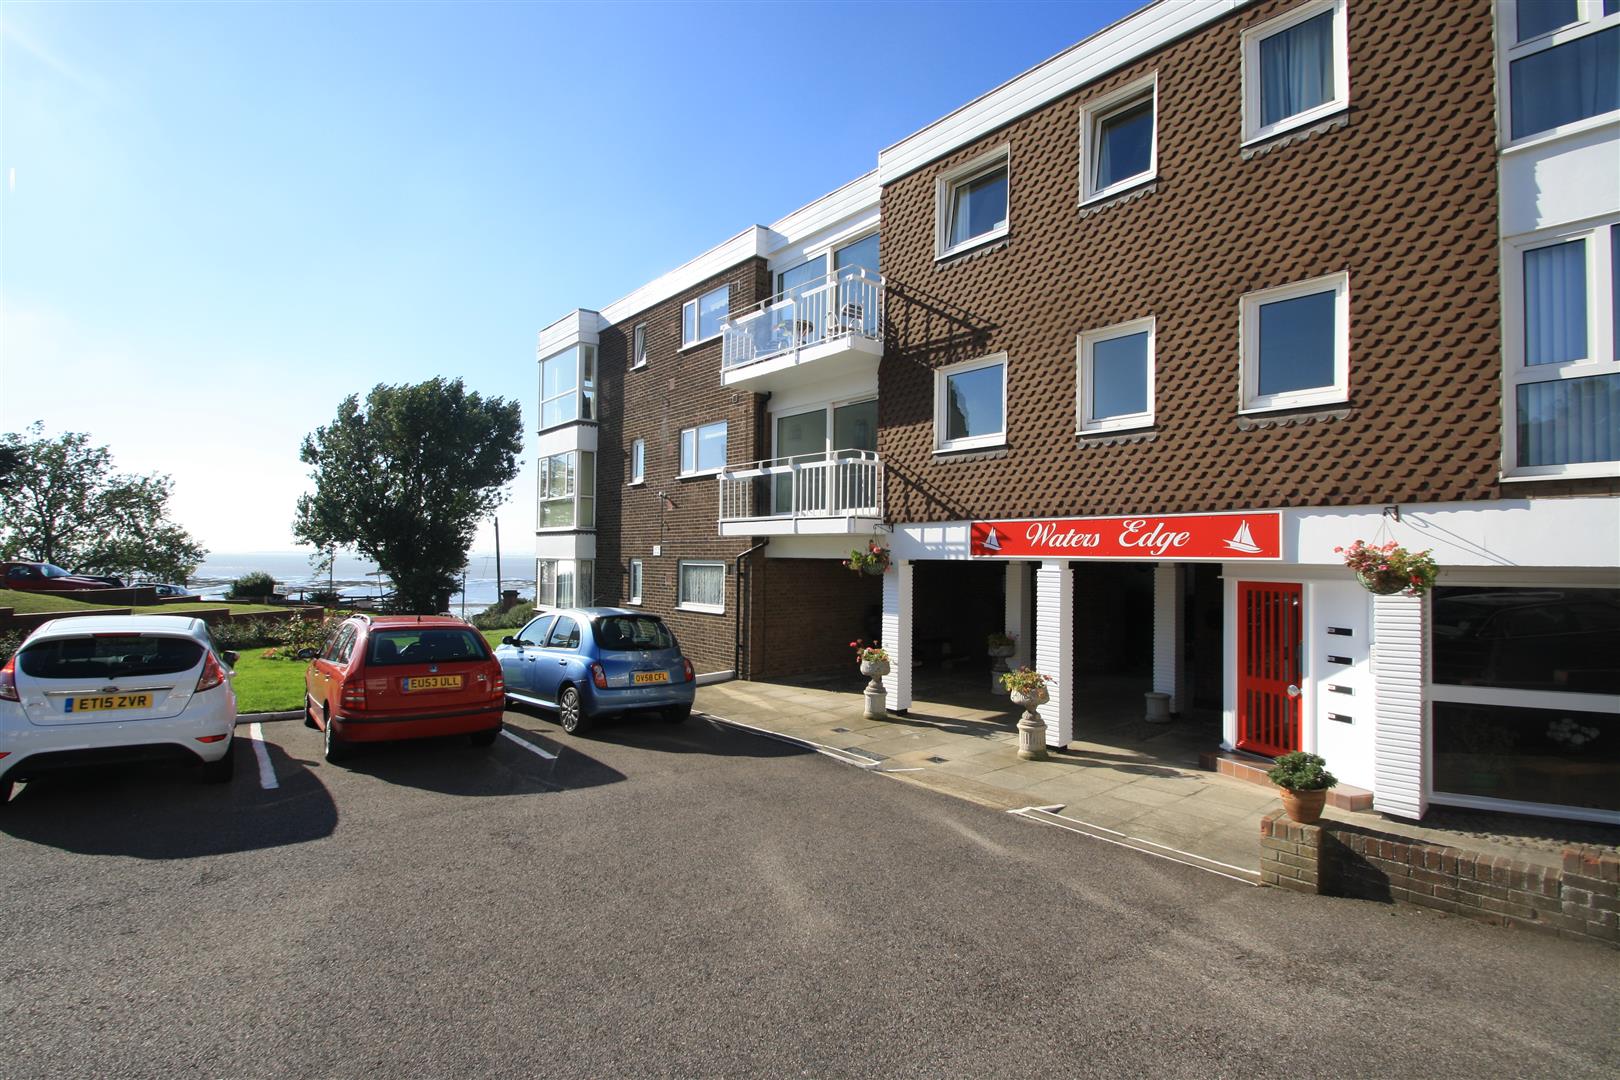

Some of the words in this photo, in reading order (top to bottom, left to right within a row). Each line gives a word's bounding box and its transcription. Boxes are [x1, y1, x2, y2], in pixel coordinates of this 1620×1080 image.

[1026, 522, 1100, 548] Waters
[1118, 520, 1190, 555] Edge
[411, 677, 438, 689] EU53
[440, 676, 460, 687] ULL
[654, 673, 667, 681] CFL
[79, 697, 113, 710] ET15
[118, 695, 147, 708] ZVR
